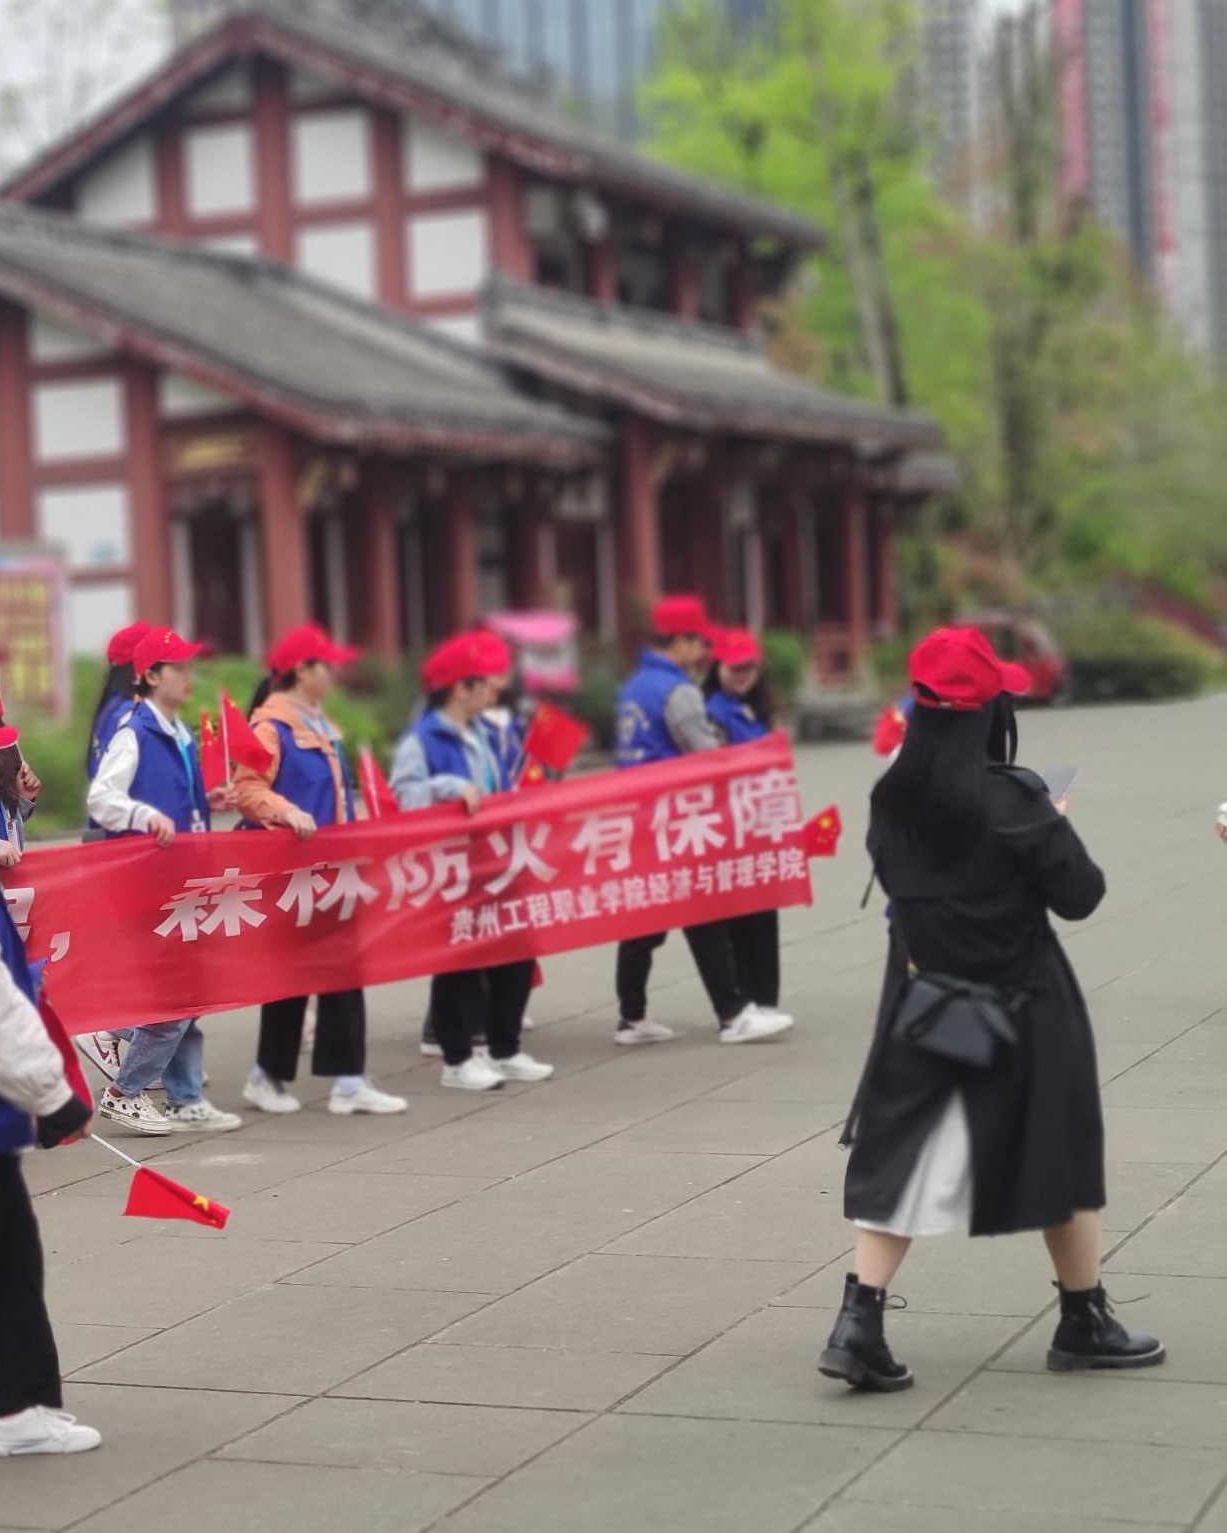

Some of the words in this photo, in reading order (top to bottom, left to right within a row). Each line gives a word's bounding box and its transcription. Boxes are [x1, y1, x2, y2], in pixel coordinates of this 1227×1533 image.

[450, 848, 806, 944] 贵州工程职业学院经济与管理学院
